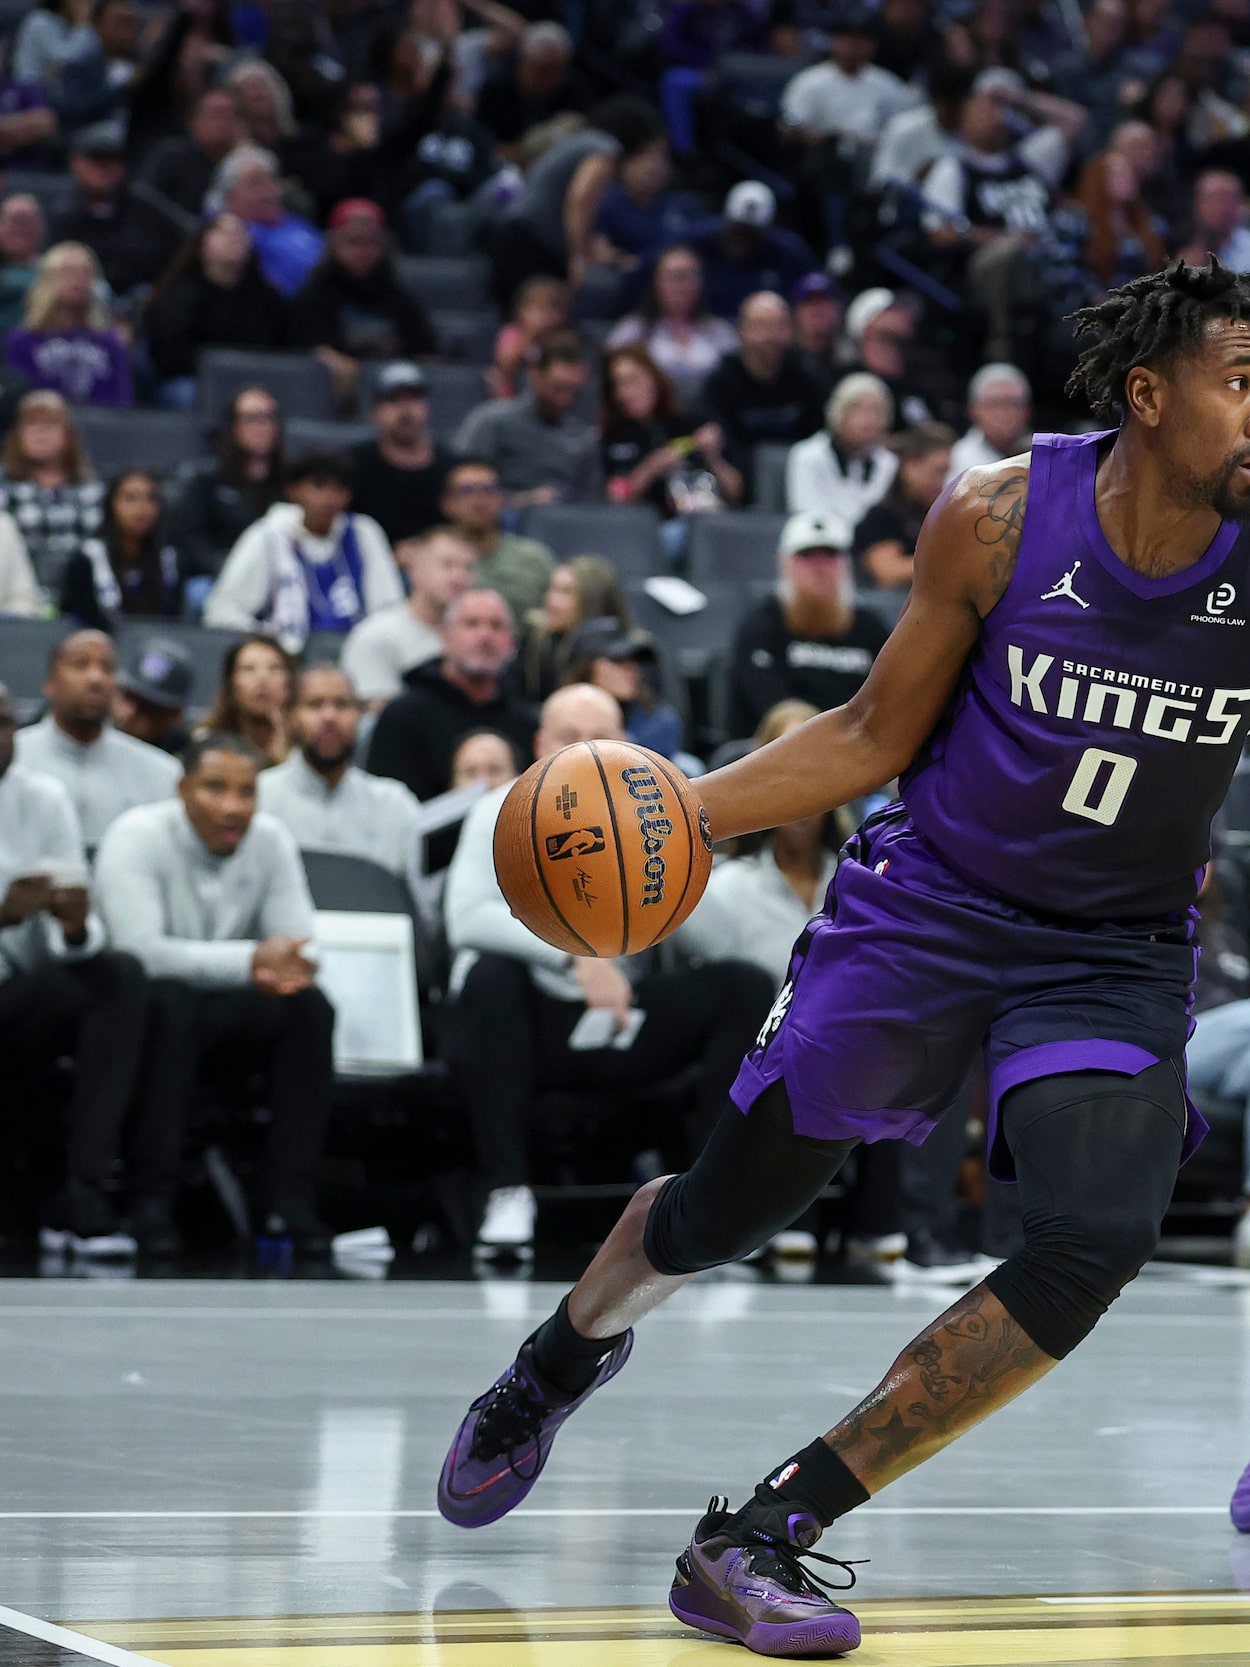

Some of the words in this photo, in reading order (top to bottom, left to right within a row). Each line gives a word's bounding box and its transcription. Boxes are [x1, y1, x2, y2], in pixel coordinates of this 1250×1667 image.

[1190, 614, 1226, 625] PHOONG
[1226, 618, 1246, 626] LAW
[1063, 660, 1203, 698] SACRAMENTO
[1062, 747, 1138, 826] 0
[620, 764, 673, 908] Wilson
